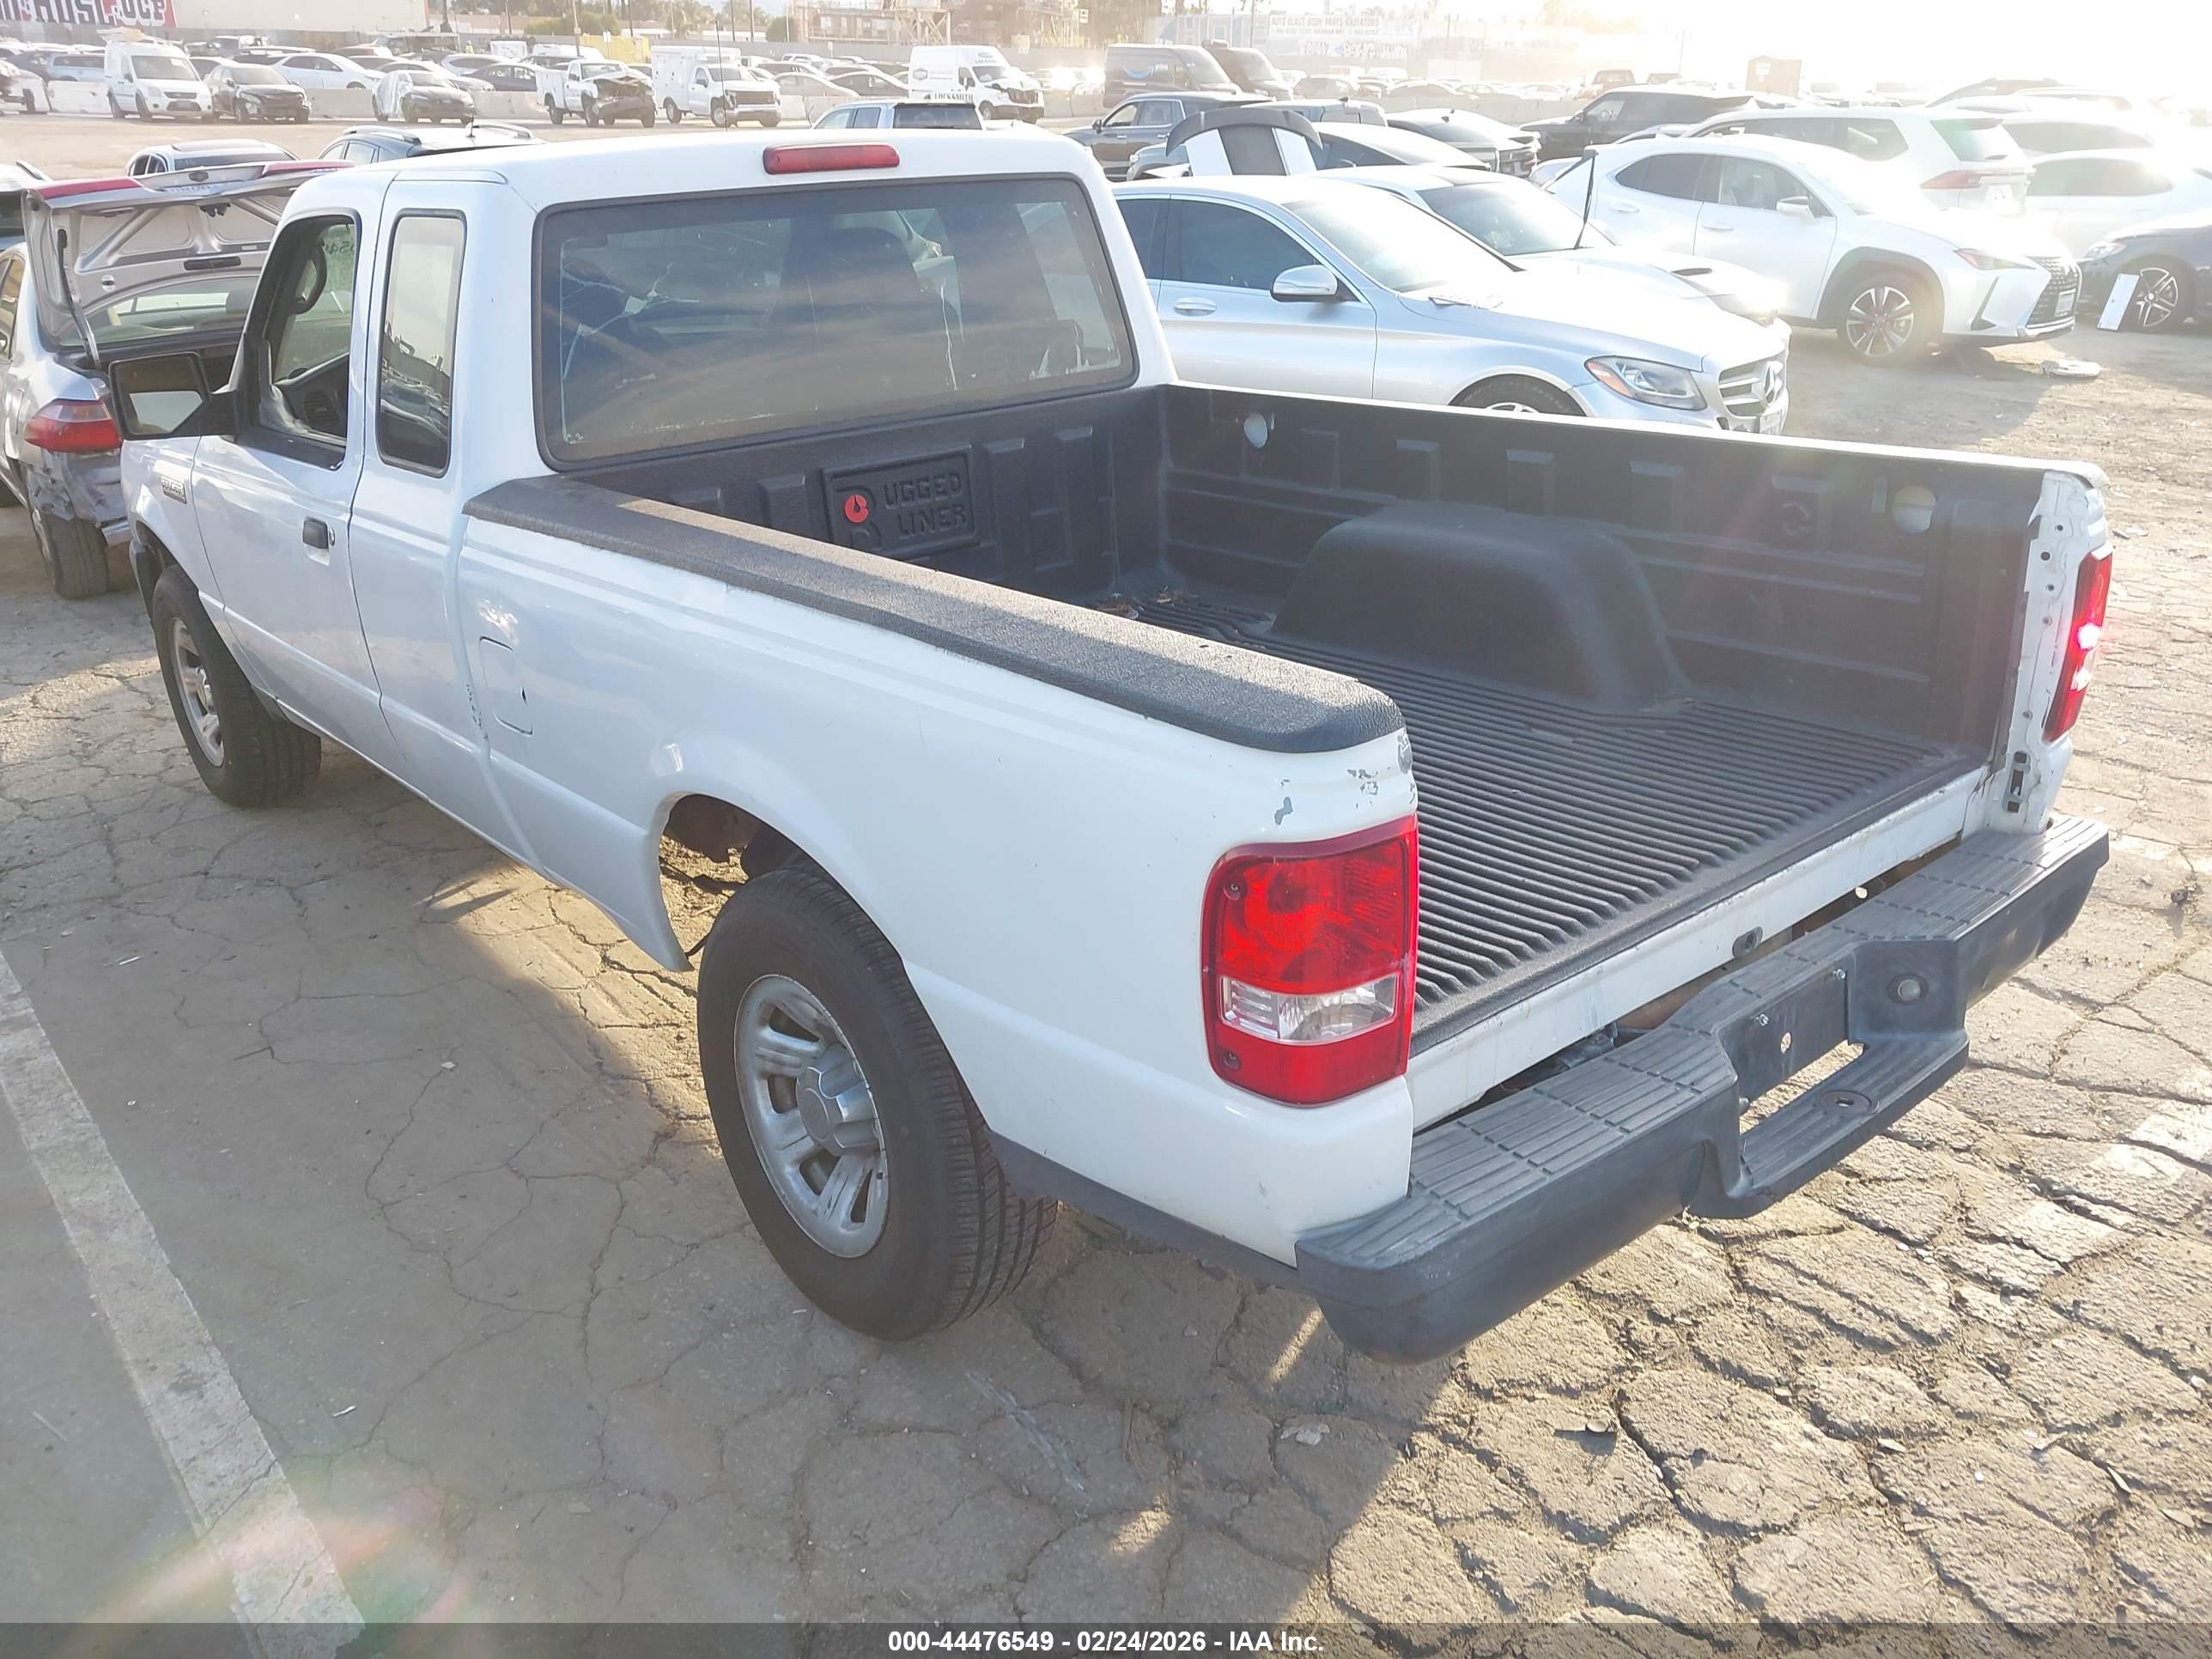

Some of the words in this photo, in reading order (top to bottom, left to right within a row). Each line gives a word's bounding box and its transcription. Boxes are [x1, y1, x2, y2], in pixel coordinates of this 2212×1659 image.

[1271, 18, 1285, 27] AUTO
[934, 92, 974, 101] LOCKSMITH
[897, 502, 967, 539] LINER
